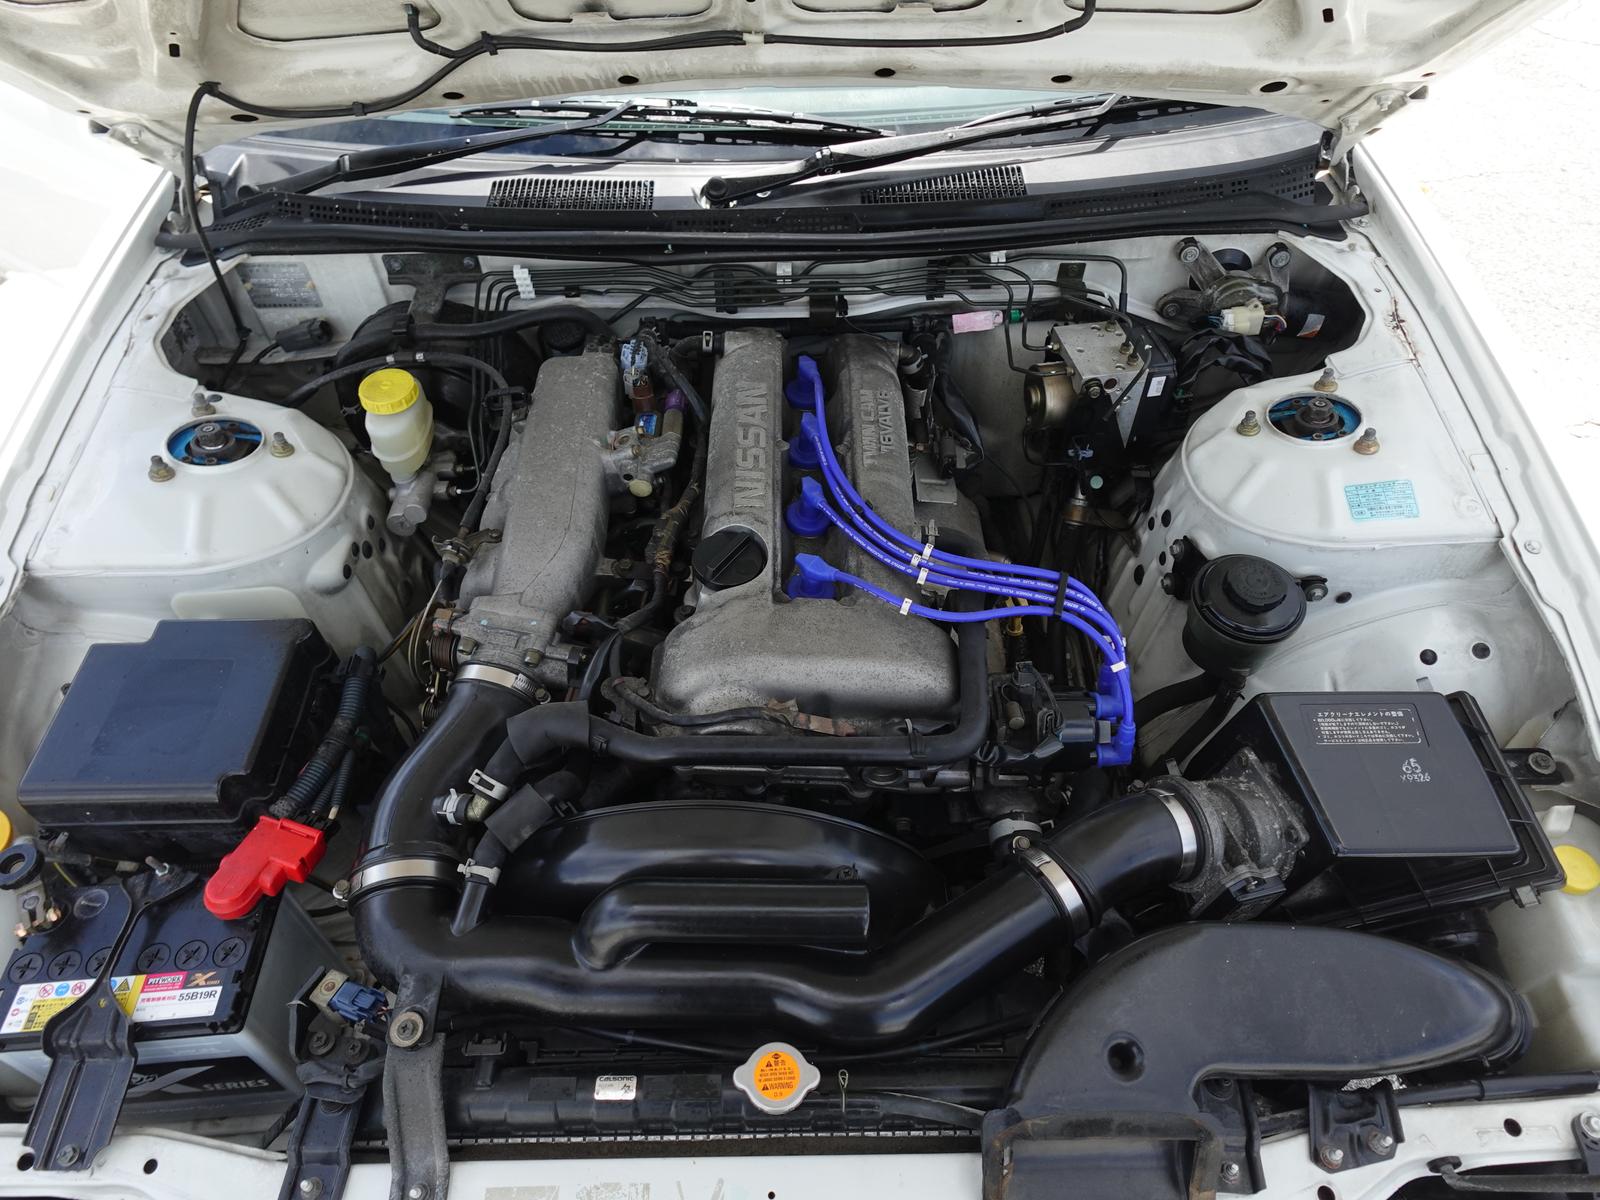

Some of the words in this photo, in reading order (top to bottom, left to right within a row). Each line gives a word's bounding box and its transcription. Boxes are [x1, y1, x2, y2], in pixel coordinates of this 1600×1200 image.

[860, 389, 874, 421] CAM
[734, 382, 769, 508] NISSAN
[861, 424, 877, 466] TWIN
[1402, 758, 1422, 774] 65
[147, 975, 183, 985] PITWORK
[178, 990, 218, 1002] 55B19R
[202, 1079, 270, 1092] SERIES
[769, 1082, 794, 1090] WARNING
